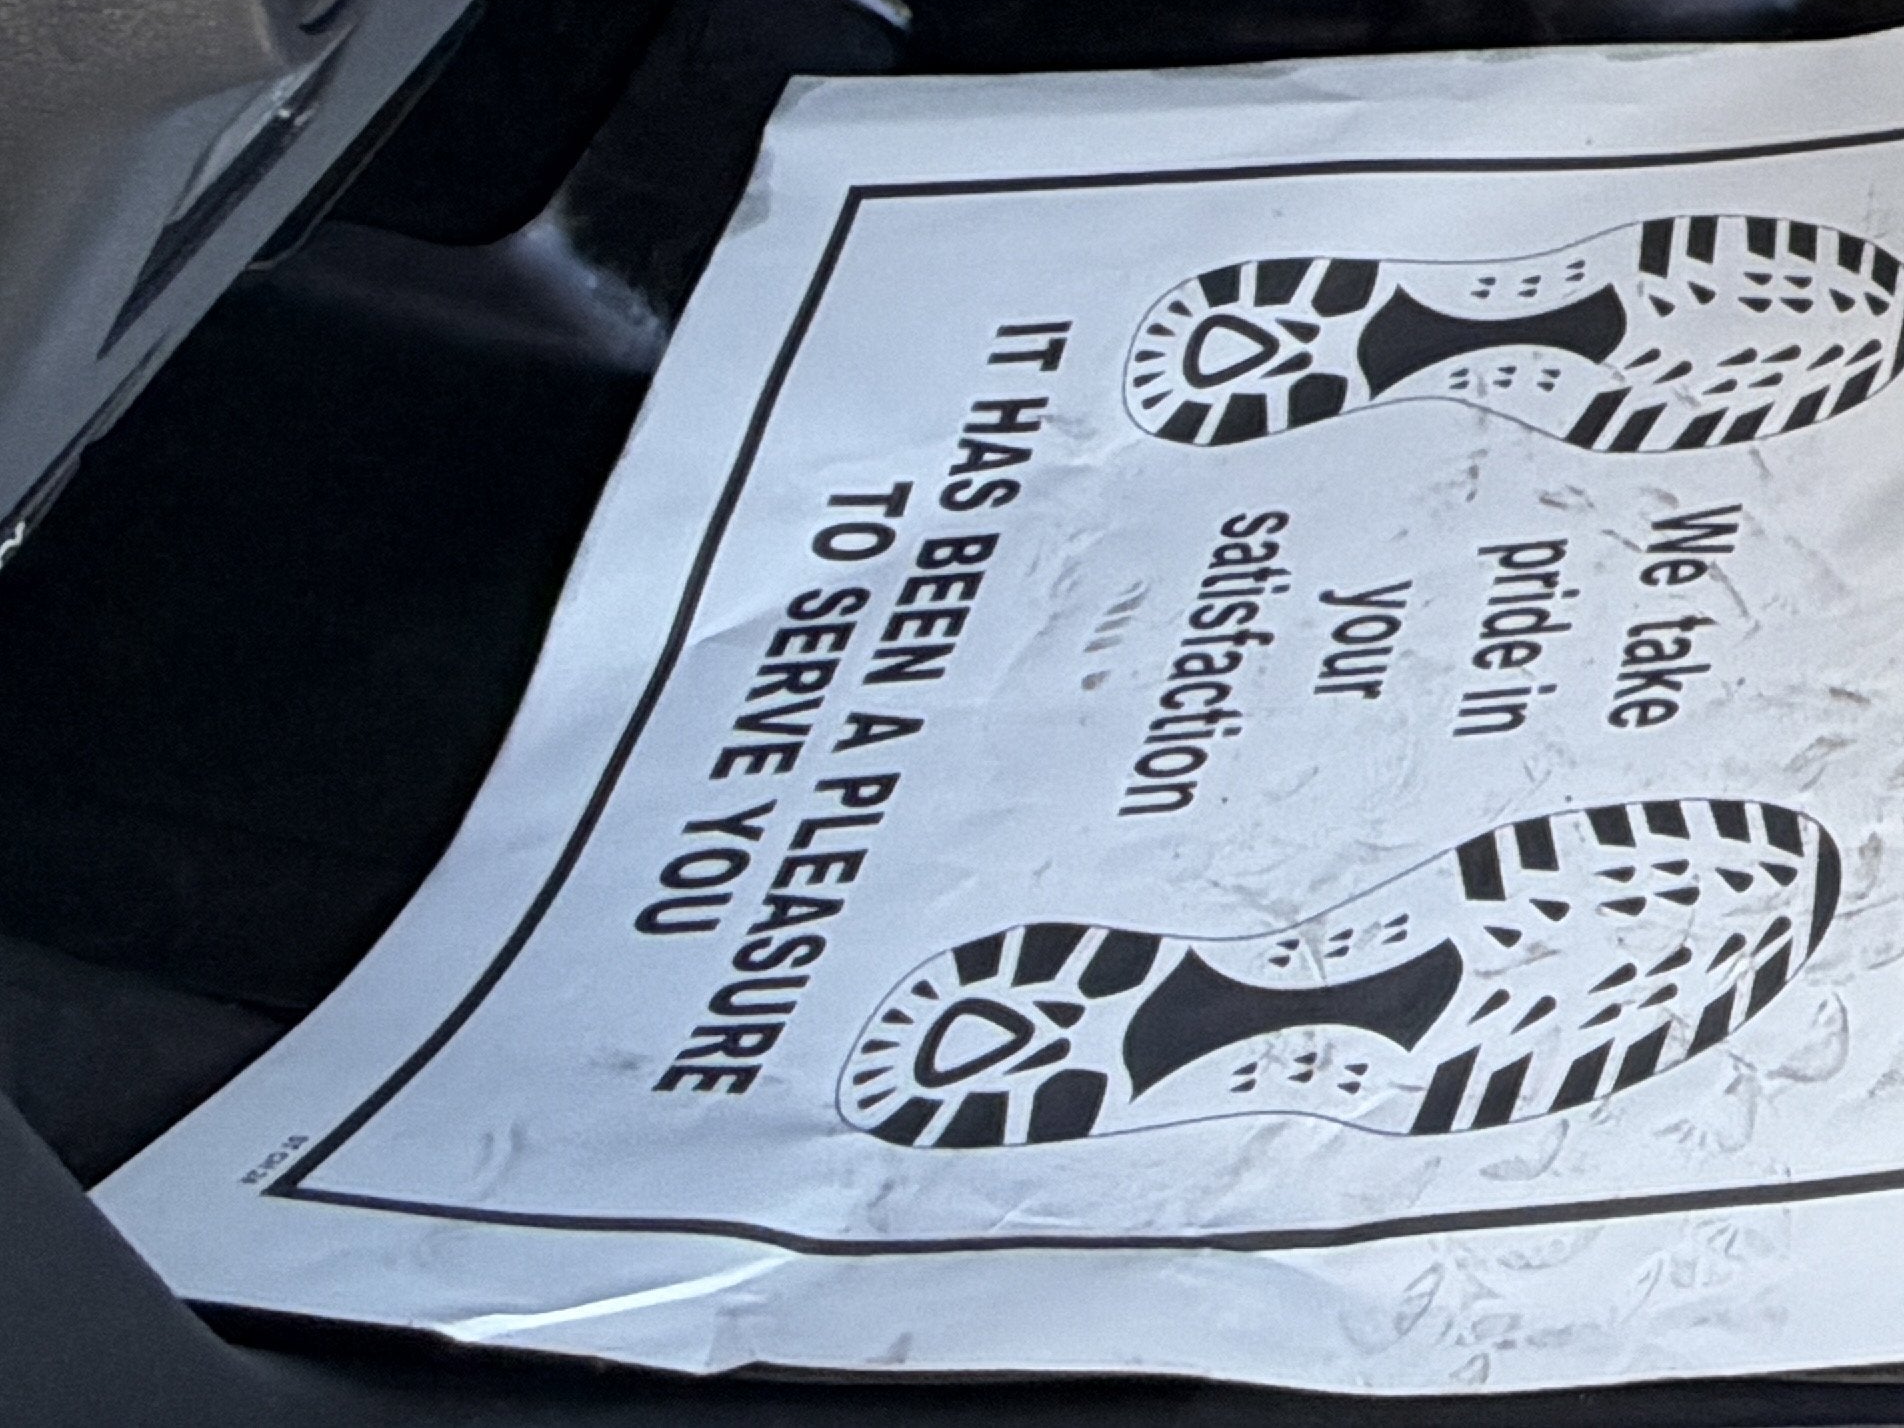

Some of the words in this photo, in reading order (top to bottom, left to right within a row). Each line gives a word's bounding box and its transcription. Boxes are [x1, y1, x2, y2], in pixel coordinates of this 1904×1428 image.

[987, 319, 1073, 372] IT
[940, 396, 1050, 512] HAS
[811, 481, 914, 562] TO
[1640, 504, 1743, 587] We
[863, 531, 1001, 685] BEEN
[1313, 580, 1413, 699] your
[1472, 538, 1581, 670] pride
[709, 585, 872, 780] SERVE
[1118, 510, 1291, 816] satisfaction
[1453, 683, 1557, 737] in
[1606, 615, 1716, 729] take
[832, 711, 925, 753] A
[634, 798, 777, 936] YOU
[651, 772, 902, 1095] PLEASURE
